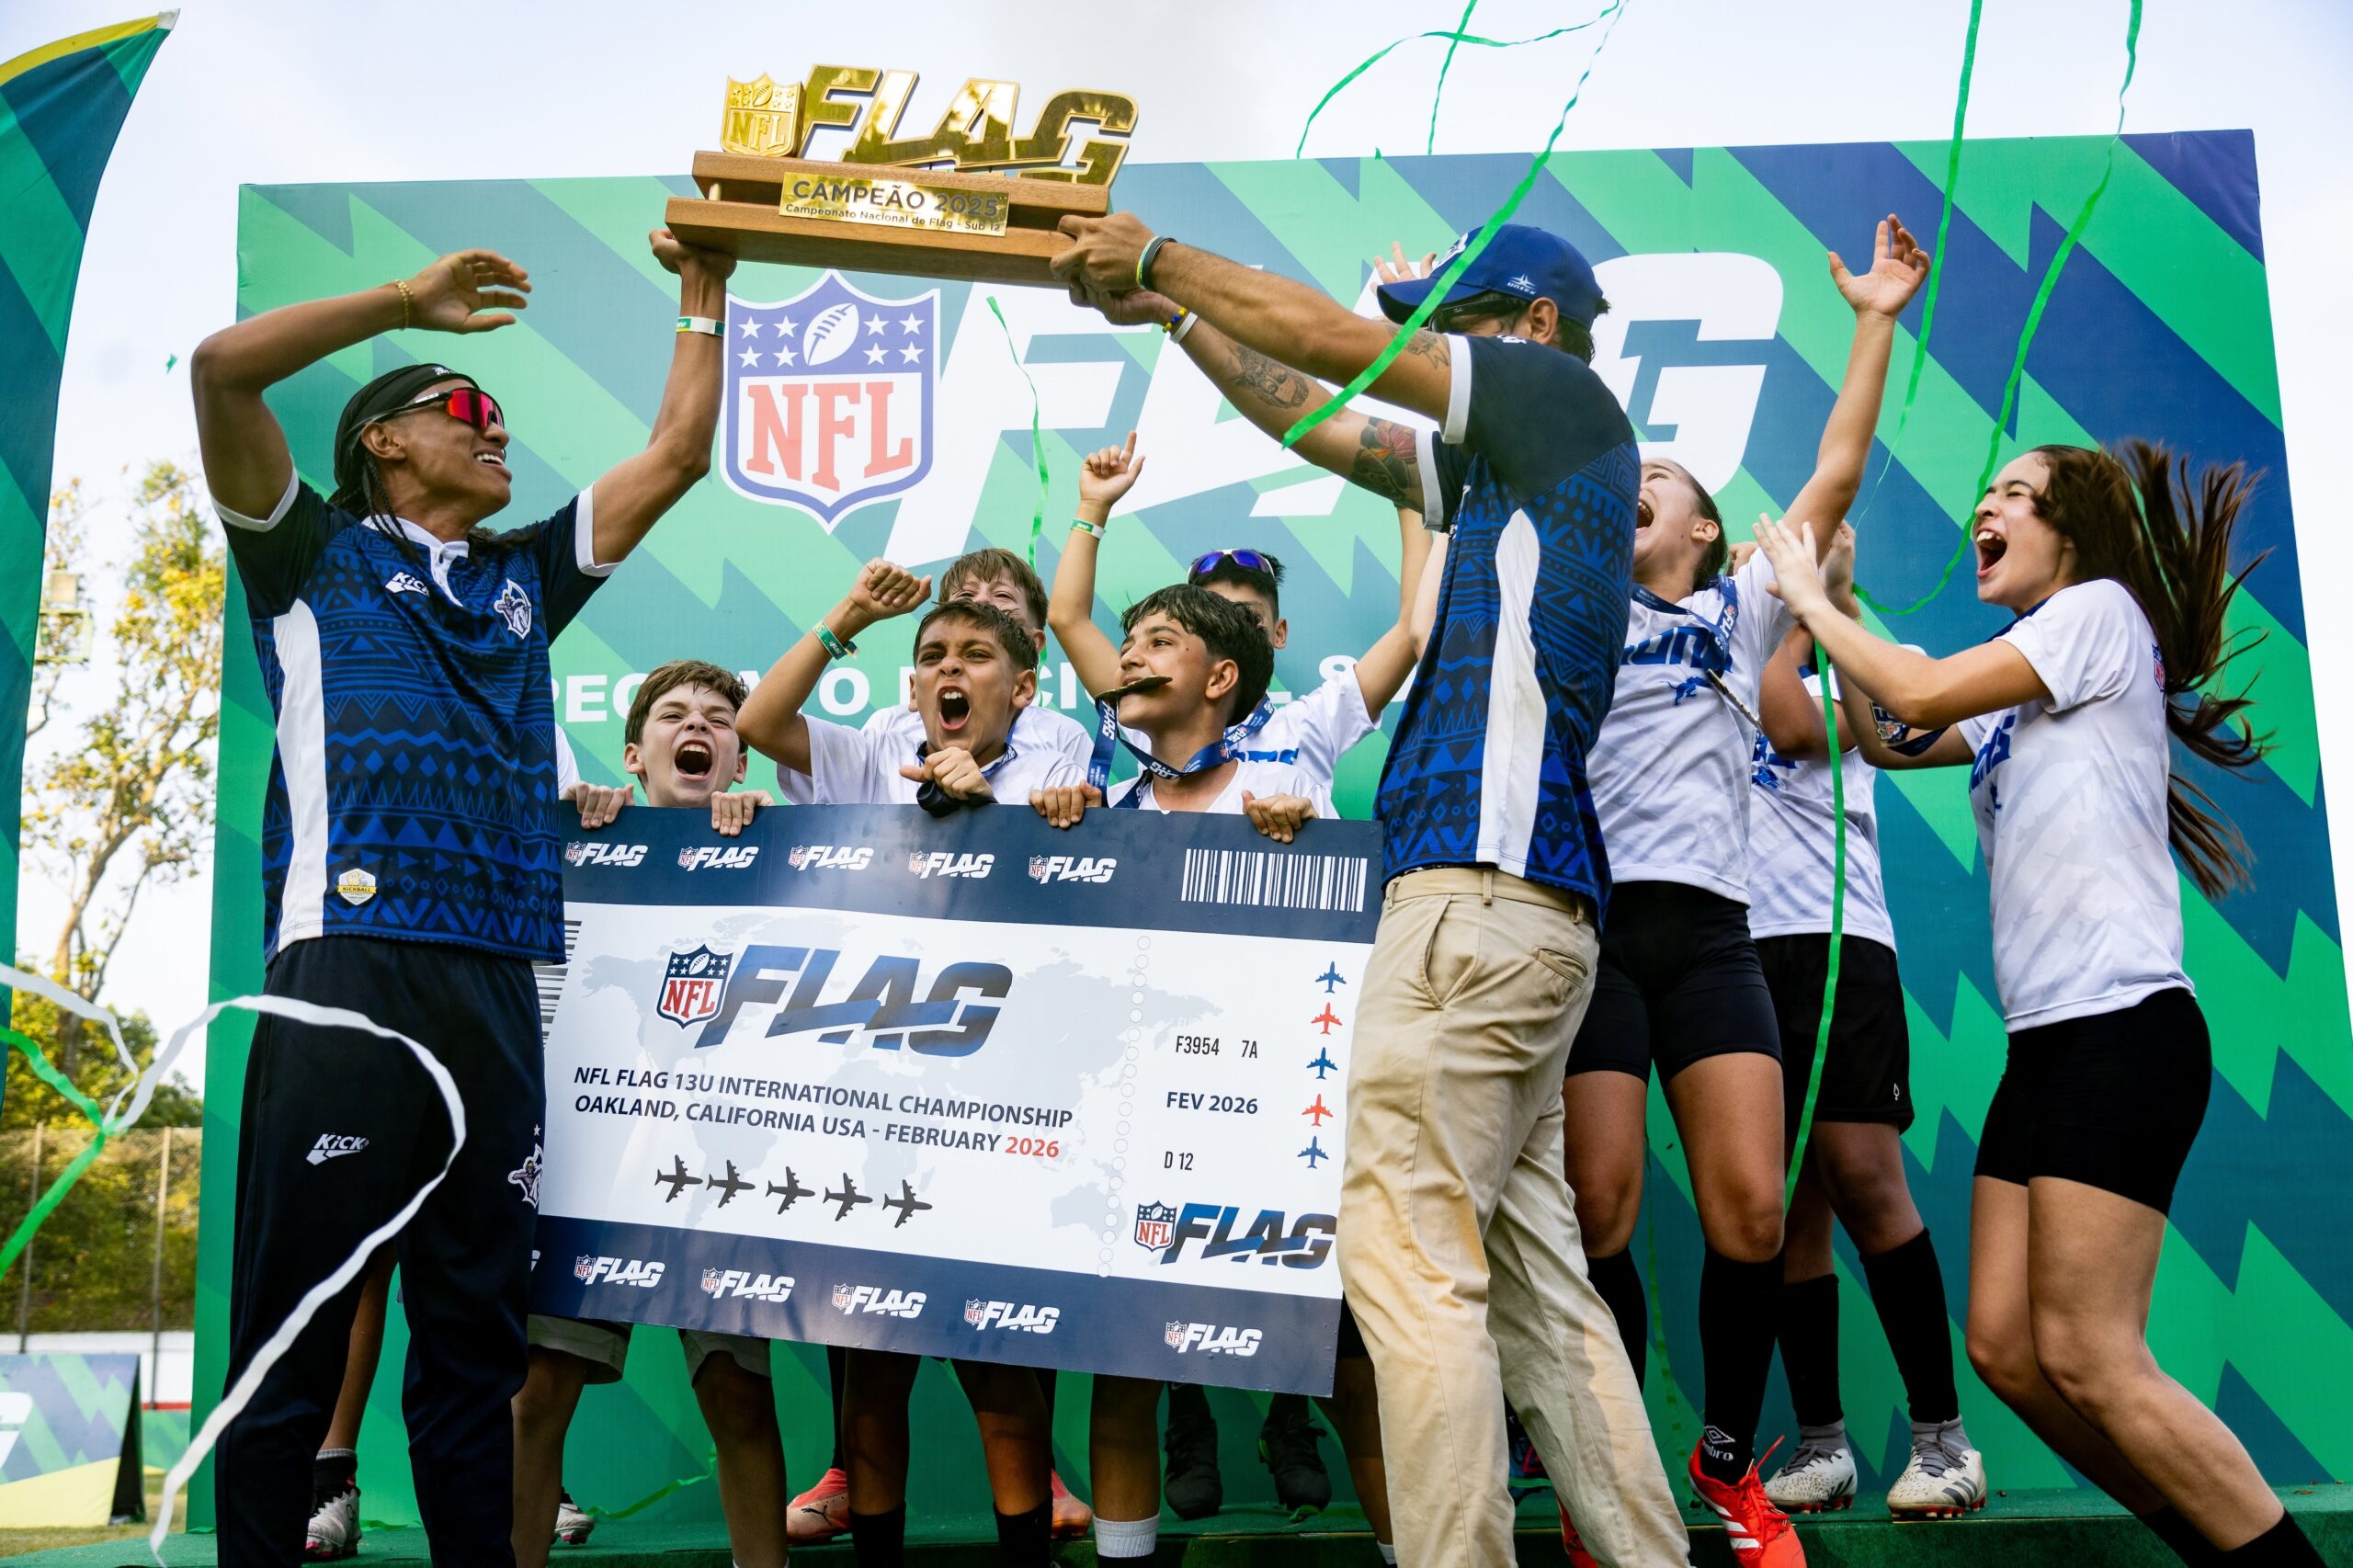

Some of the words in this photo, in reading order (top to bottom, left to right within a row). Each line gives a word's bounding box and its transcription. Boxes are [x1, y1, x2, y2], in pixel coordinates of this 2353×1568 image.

[726, 111, 787, 147] NFL
[799, 63, 1139, 187] FLAG
[793, 180, 925, 210] CAMPEÃO
[934, 193, 999, 218] 2025
[786, 204, 856, 219] Campeonato
[860, 211, 908, 223] Nacional
[912, 216, 926, 225] de
[929, 217, 953, 230] Flag
[965, 221, 985, 232] Sub
[990, 222, 1001, 232] 12
[746, 381, 914, 493] NFL
[574, 843, 648, 867] FLAG
[687, 846, 759, 871] FLAG
[798, 846, 874, 870] FLAG
[919, 852, 995, 879] FLAG
[1040, 856, 1118, 884] FLAG
[662, 980, 716, 1019] NFL
[694, 944, 1013, 1058] FLAG
[1176, 1035, 1220, 1056] F3954
[1242, 1040, 1258, 1059] 7A
[574, 1066, 610, 1085] NFL
[616, 1069, 668, 1089] FLAG
[676, 1074, 714, 1092] 13U
[719, 1075, 893, 1111] INTERNATIONAL
[899, 1095, 1074, 1128] CHAMPIONSHIP
[1166, 1091, 1205, 1110] FEV
[1209, 1095, 1258, 1115] 2026
[574, 1095, 679, 1121] OAKLAND,
[686, 1103, 815, 1133] CALIFORNIA
[822, 1116, 866, 1139] USA
[884, 1123, 1002, 1153] FEBRUARY
[1005, 1136, 1060, 1158] 2026
[1164, 1151, 1174, 1169] D
[1178, 1152, 1194, 1171] 12
[1137, 1221, 1170, 1247] NFL
[1160, 1202, 1337, 1270] FLAG
[585, 1256, 665, 1288] FLAG
[712, 1269, 796, 1303] FLAG
[844, 1286, 927, 1319] FLAG
[976, 1301, 1060, 1334] FLAG
[1177, 1323, 1263, 1356] FLAG
